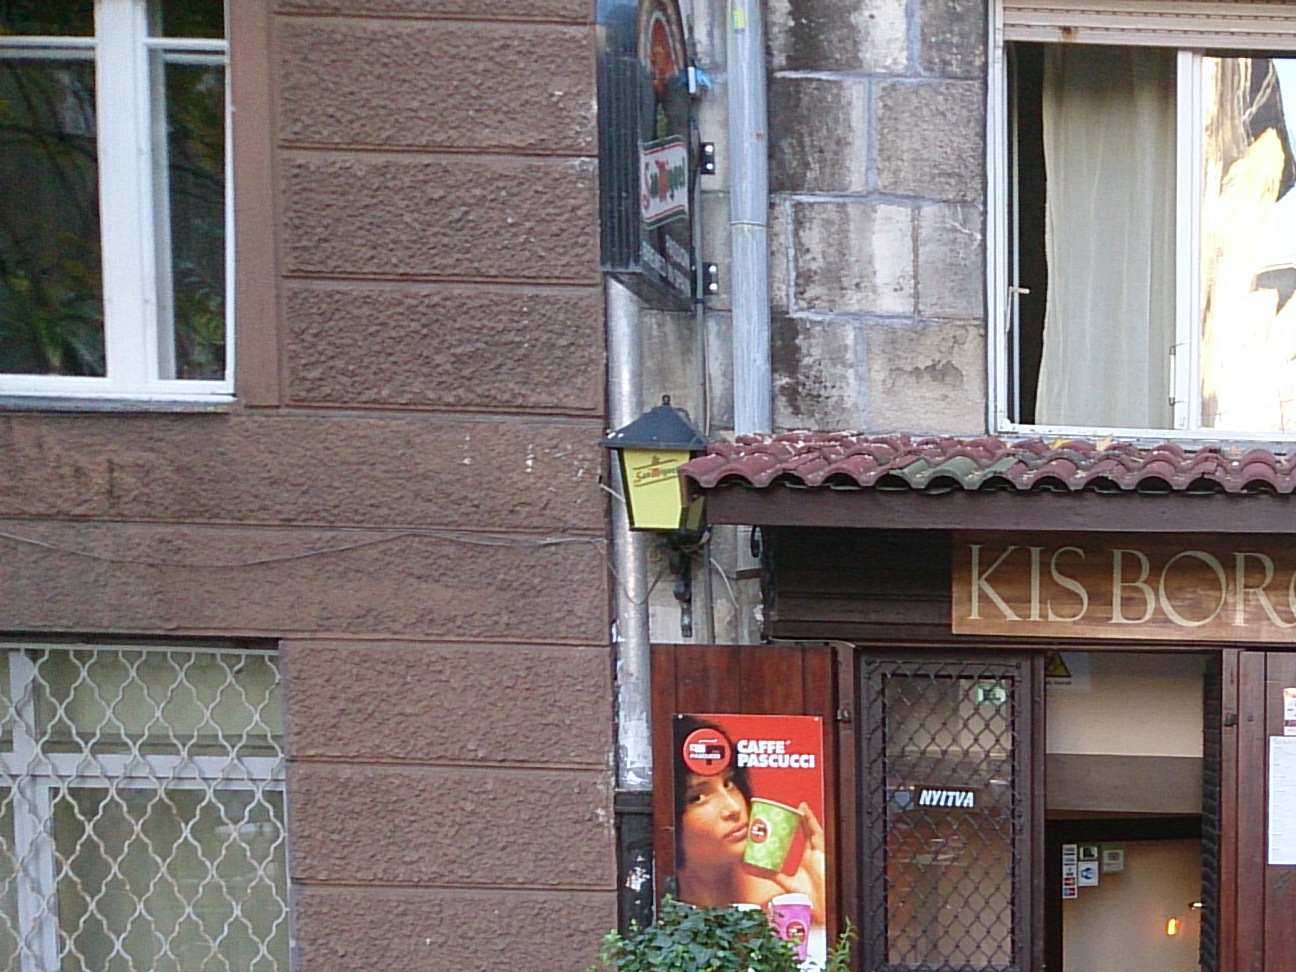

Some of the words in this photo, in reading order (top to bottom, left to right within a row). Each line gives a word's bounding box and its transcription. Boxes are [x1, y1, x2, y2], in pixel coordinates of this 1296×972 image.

[967, 543, 1089, 623] KIS
[737, 754, 816, 768] PASCUCCI
[919, 789, 974, 808] NYITVA
